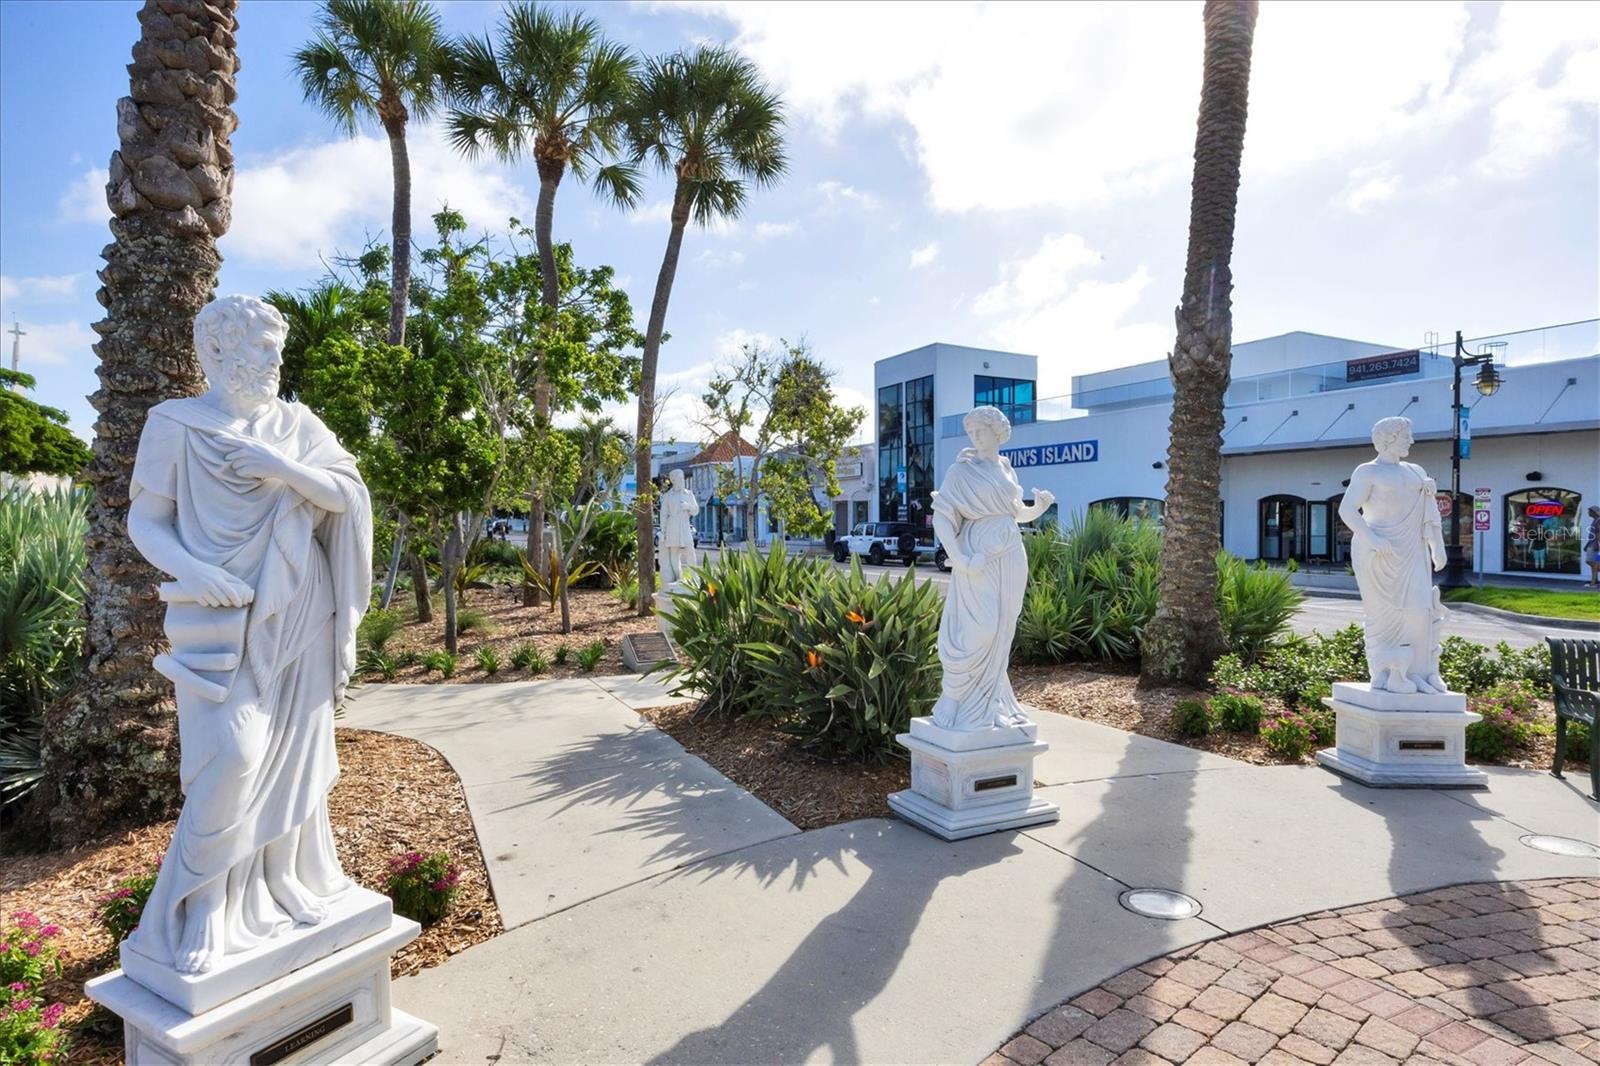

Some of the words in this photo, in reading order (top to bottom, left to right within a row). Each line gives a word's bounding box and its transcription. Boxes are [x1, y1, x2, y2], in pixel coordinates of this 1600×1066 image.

[1001, 448, 1038, 466] VIN'S
[1041, 443, 1095, 464] ISLAND
[1526, 504, 1564, 516] OPEN
[284, 1025, 326, 1053] LEARNING
